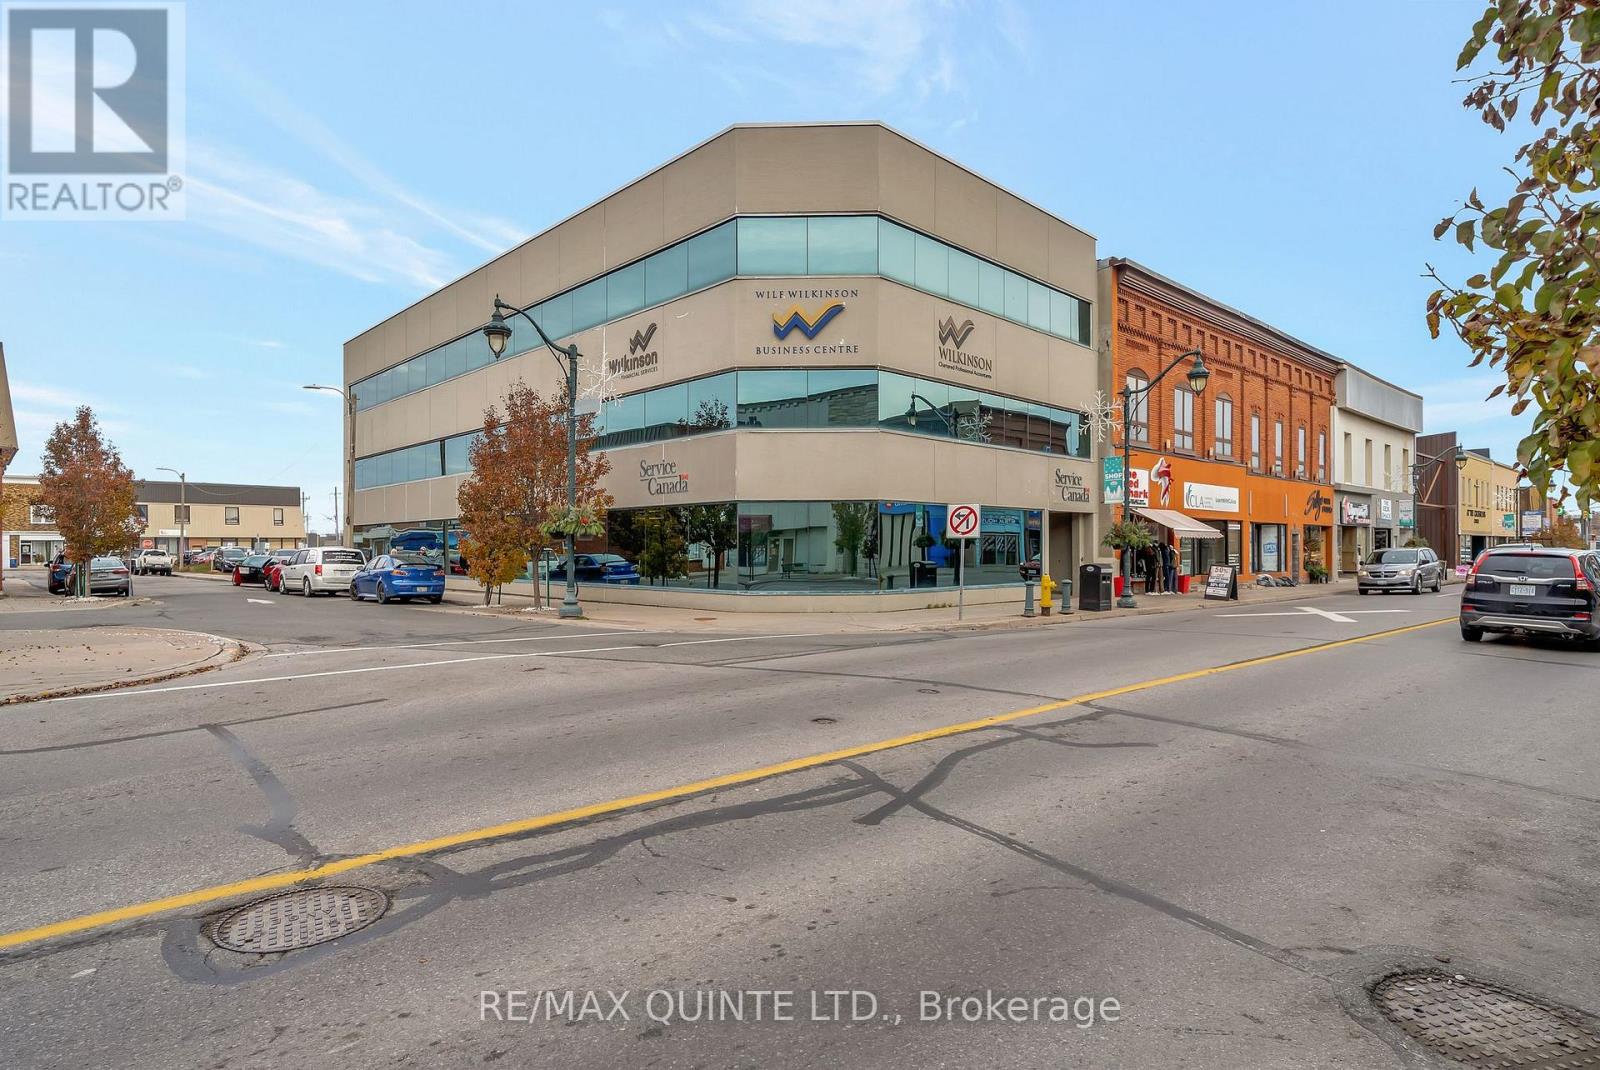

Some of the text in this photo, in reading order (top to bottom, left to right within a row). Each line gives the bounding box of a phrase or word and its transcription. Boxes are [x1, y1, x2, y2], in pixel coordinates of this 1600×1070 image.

[755, 289, 859, 299] WILF WILKINSON
[755, 345, 860, 355] BUSINESS CENTRE
[938, 345, 993, 372] WILKINSON
[608, 350, 659, 376] Wilkinson
[640, 459, 677, 478] Service
[1055, 468, 1083, 486] Service
[1104, 472, 1123, 480] SHOP
[647, 474, 689, 496] Canada
[1061, 486, 1090, 503] Canada
